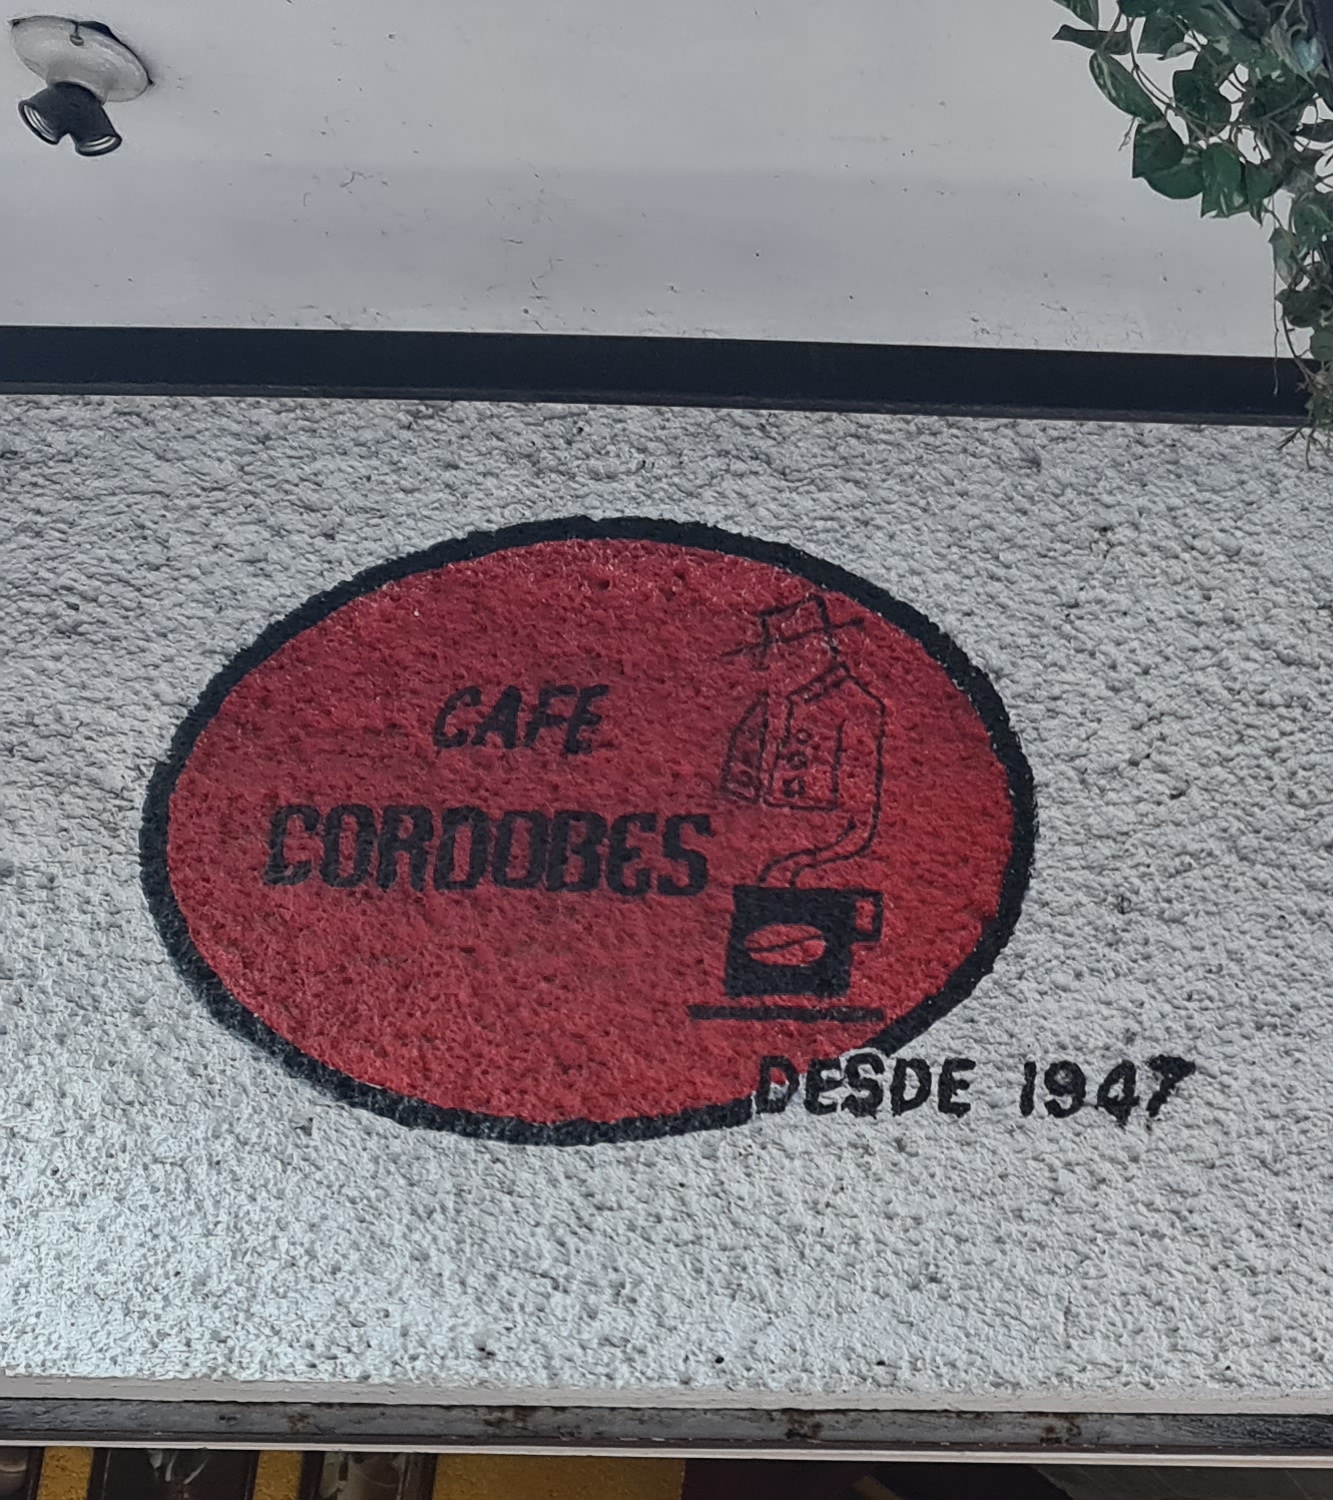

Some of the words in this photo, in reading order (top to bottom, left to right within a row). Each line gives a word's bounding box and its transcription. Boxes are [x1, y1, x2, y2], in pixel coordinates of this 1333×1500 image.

[432, 683, 611, 755] CAFE
[261, 801, 716, 898] CORDOBES
[751, 1053, 976, 1118] DESDE
[1018, 1053, 1195, 1127] 1947
